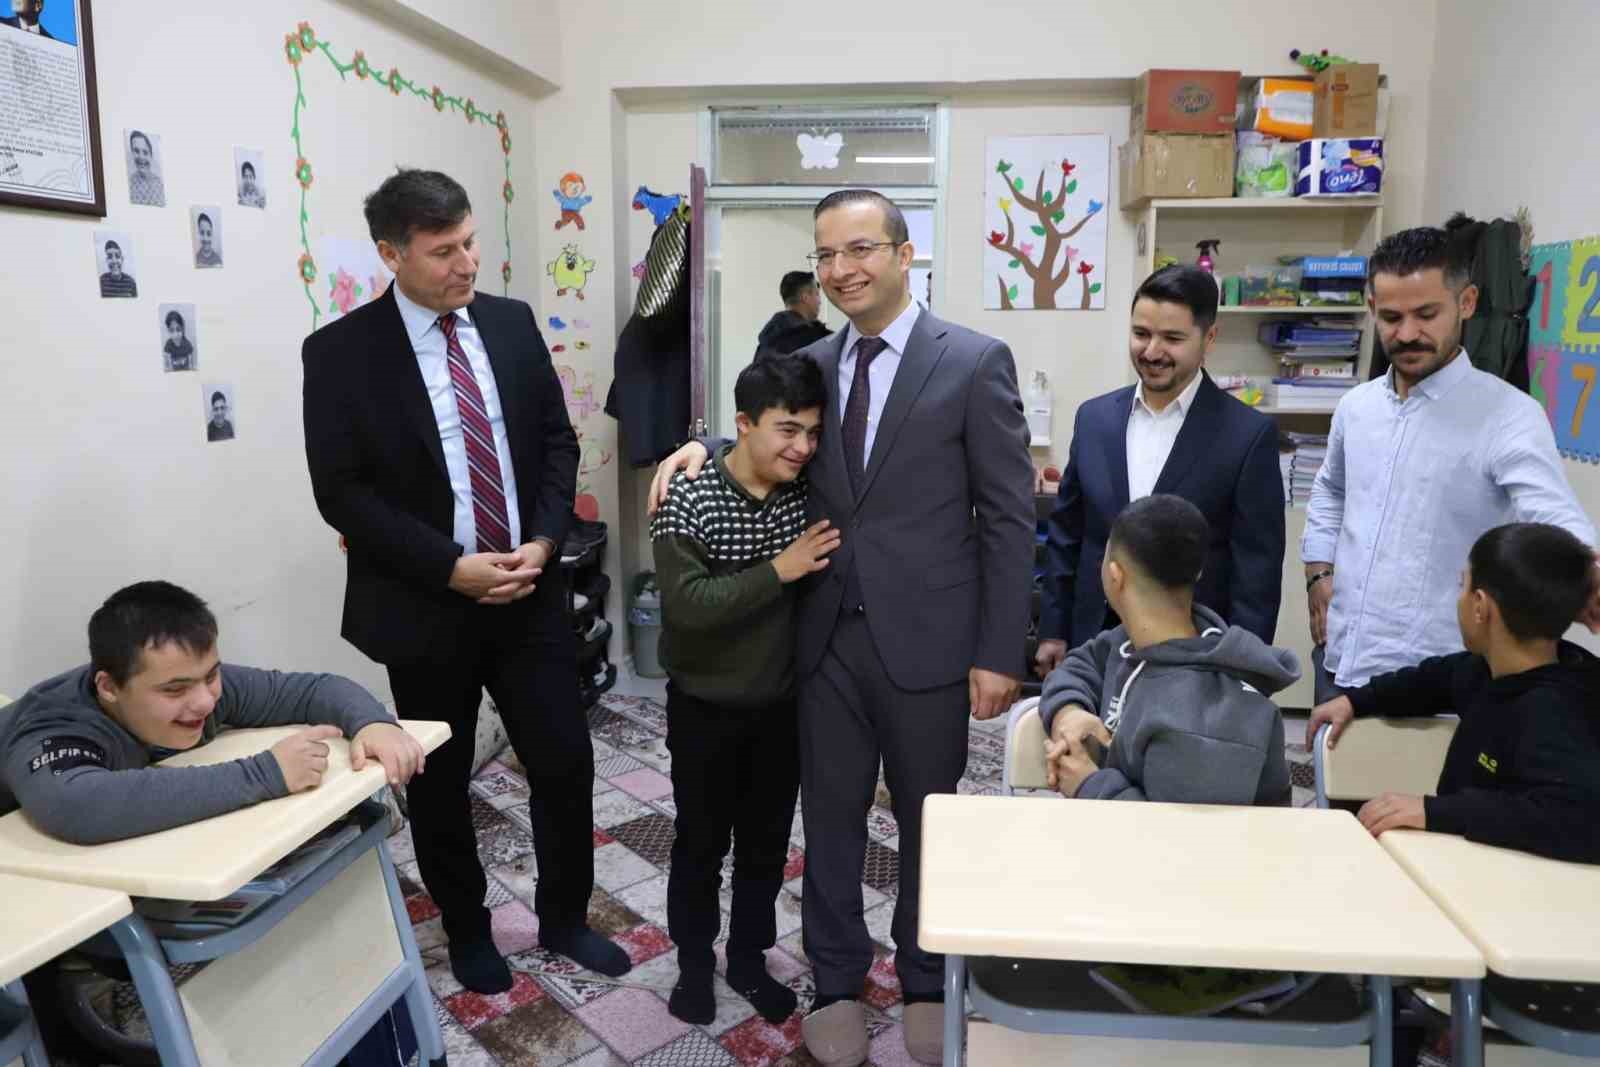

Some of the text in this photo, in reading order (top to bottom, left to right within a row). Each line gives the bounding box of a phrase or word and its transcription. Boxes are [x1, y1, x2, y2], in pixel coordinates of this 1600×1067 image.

[1537, 255, 1600, 333] 1 2
[1571, 363, 1597, 437] 7
